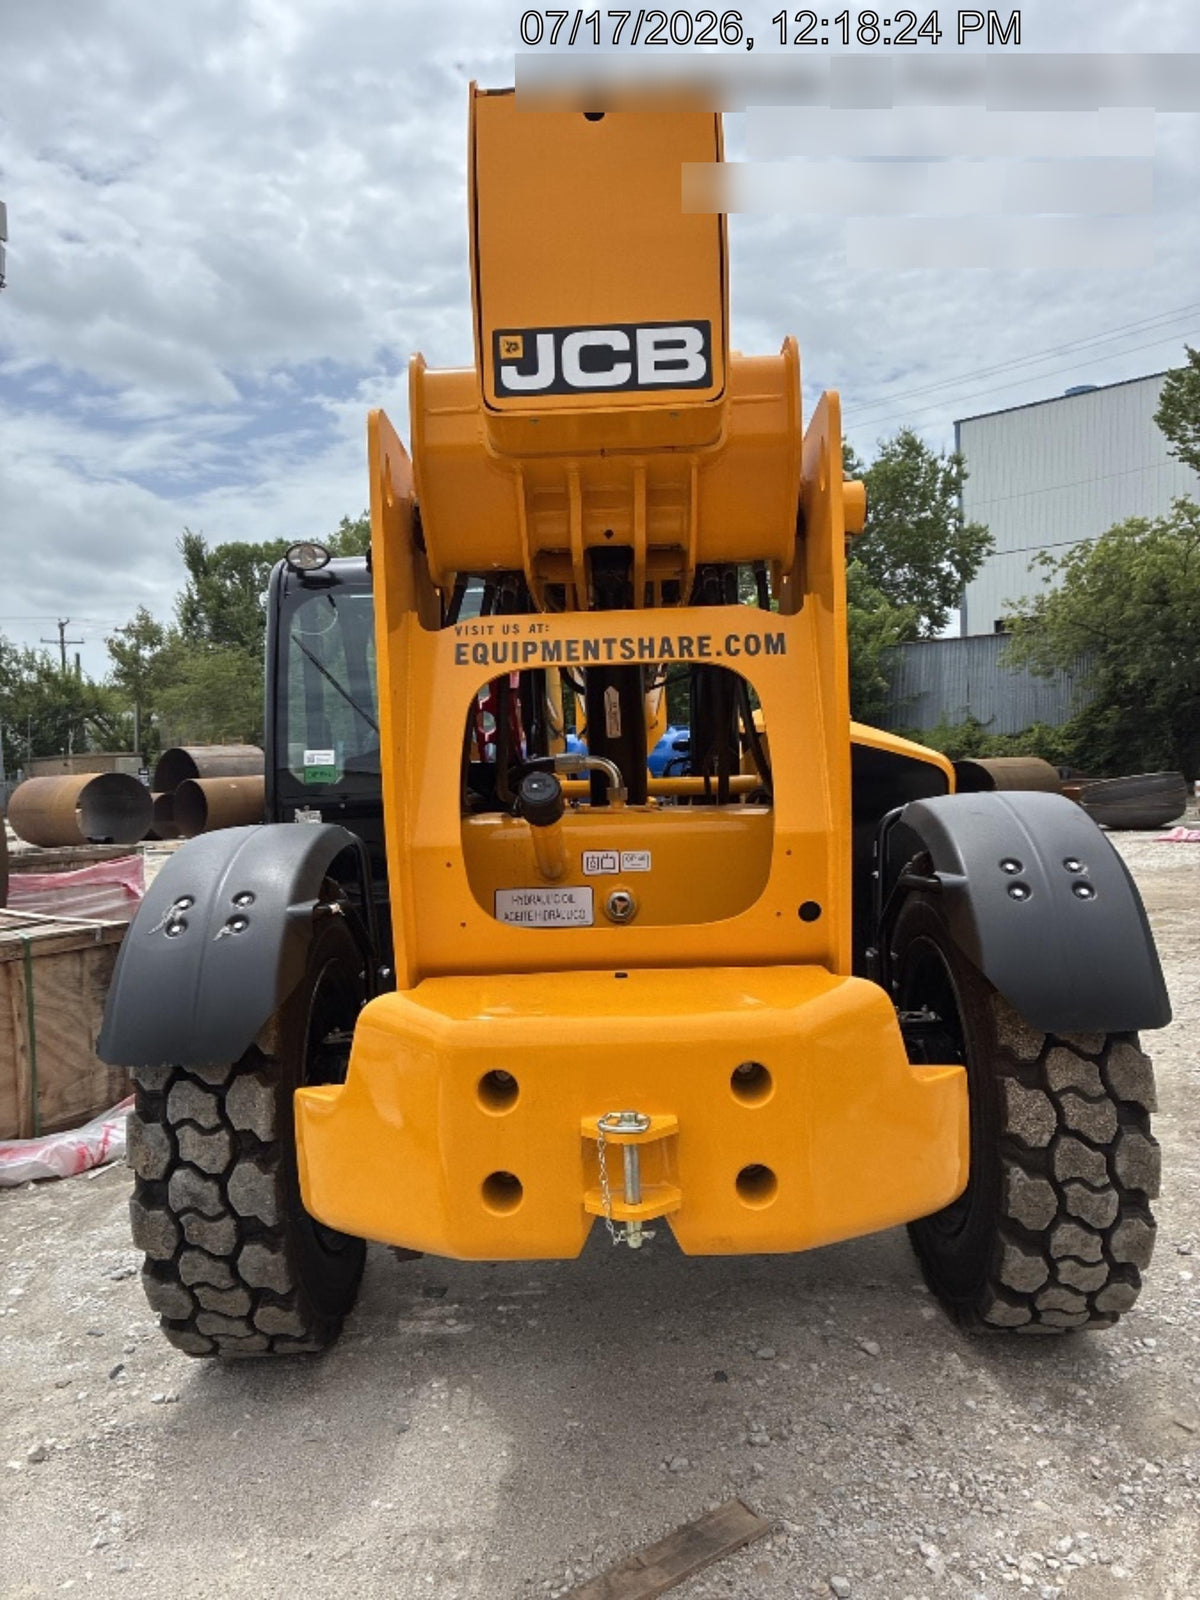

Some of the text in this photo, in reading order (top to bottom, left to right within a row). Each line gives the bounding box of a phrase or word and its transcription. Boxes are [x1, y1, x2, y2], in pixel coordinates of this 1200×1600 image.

[501, 326, 707, 390] JCB
[455, 623, 550, 636] VISIT US AT:
[454, 632, 787, 665] EQUIPMENTSHARE.COM
